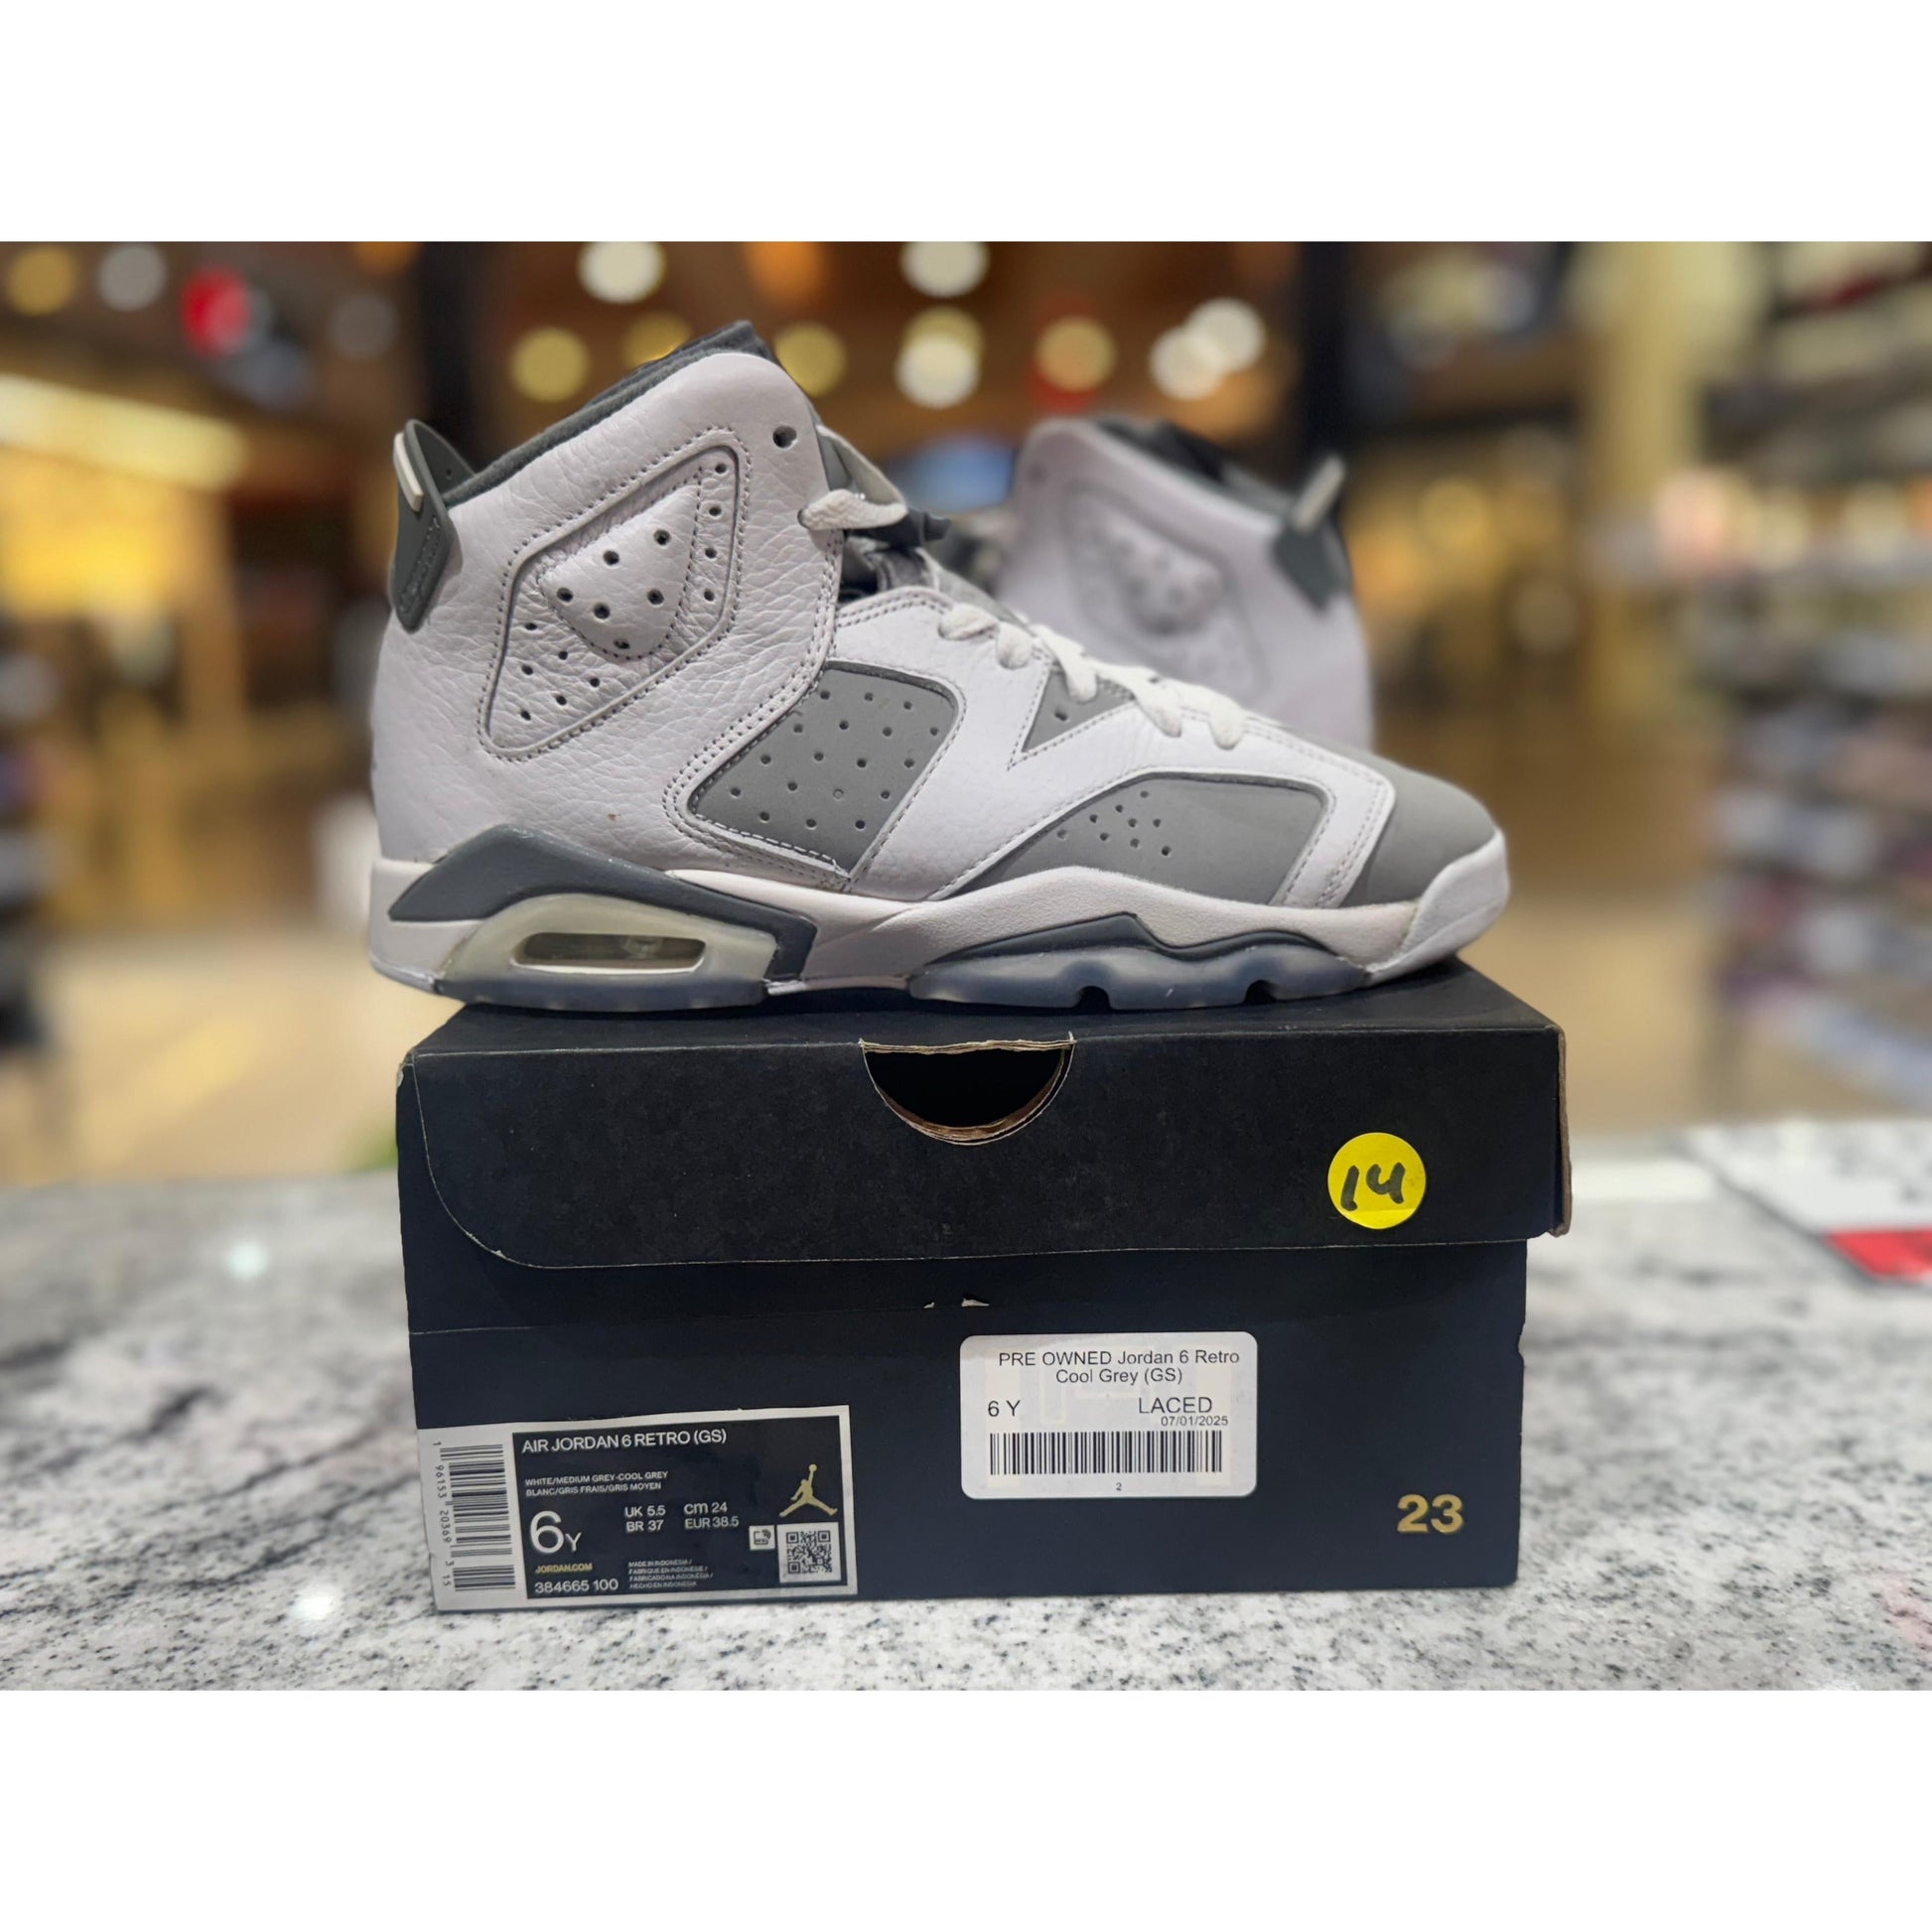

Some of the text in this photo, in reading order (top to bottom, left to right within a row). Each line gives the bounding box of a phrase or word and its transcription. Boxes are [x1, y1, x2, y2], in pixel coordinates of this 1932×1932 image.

[1340, 1162, 1406, 1211] 14
[999, 1349, 1240, 1367] PRE OWNED Jordan 6 Retro
[1055, 1367, 1183, 1387] Cool Grey (GS)
[987, 1400, 1021, 1418] 6 Y
[1138, 1397, 1213, 1414] LACED
[1161, 1415, 1229, 1428] 07/01/2025
[522, 1428, 727, 1453] AIR JORDAN 6 RETRO (GS)
[525, 1470, 668, 1487] WHITE/MEDIUM GREY-COOL GREY
[525, 1486, 579, 1497] BLANC/GRIS
[629, 1482, 662, 1491] MOYEN
[1115, 1482, 1123, 1491] 2
[624, 1505, 666, 1518] UK 5.5
[683, 1502, 728, 1515] cm 24
[1397, 1493, 1464, 1534] 23
[625, 1519, 664, 1533] BR 37
[684, 1516, 740, 1530] EUR 38.5
[535, 1563, 594, 1575] JORDAN.COM
[534, 1578, 620, 1593] 384665 100
